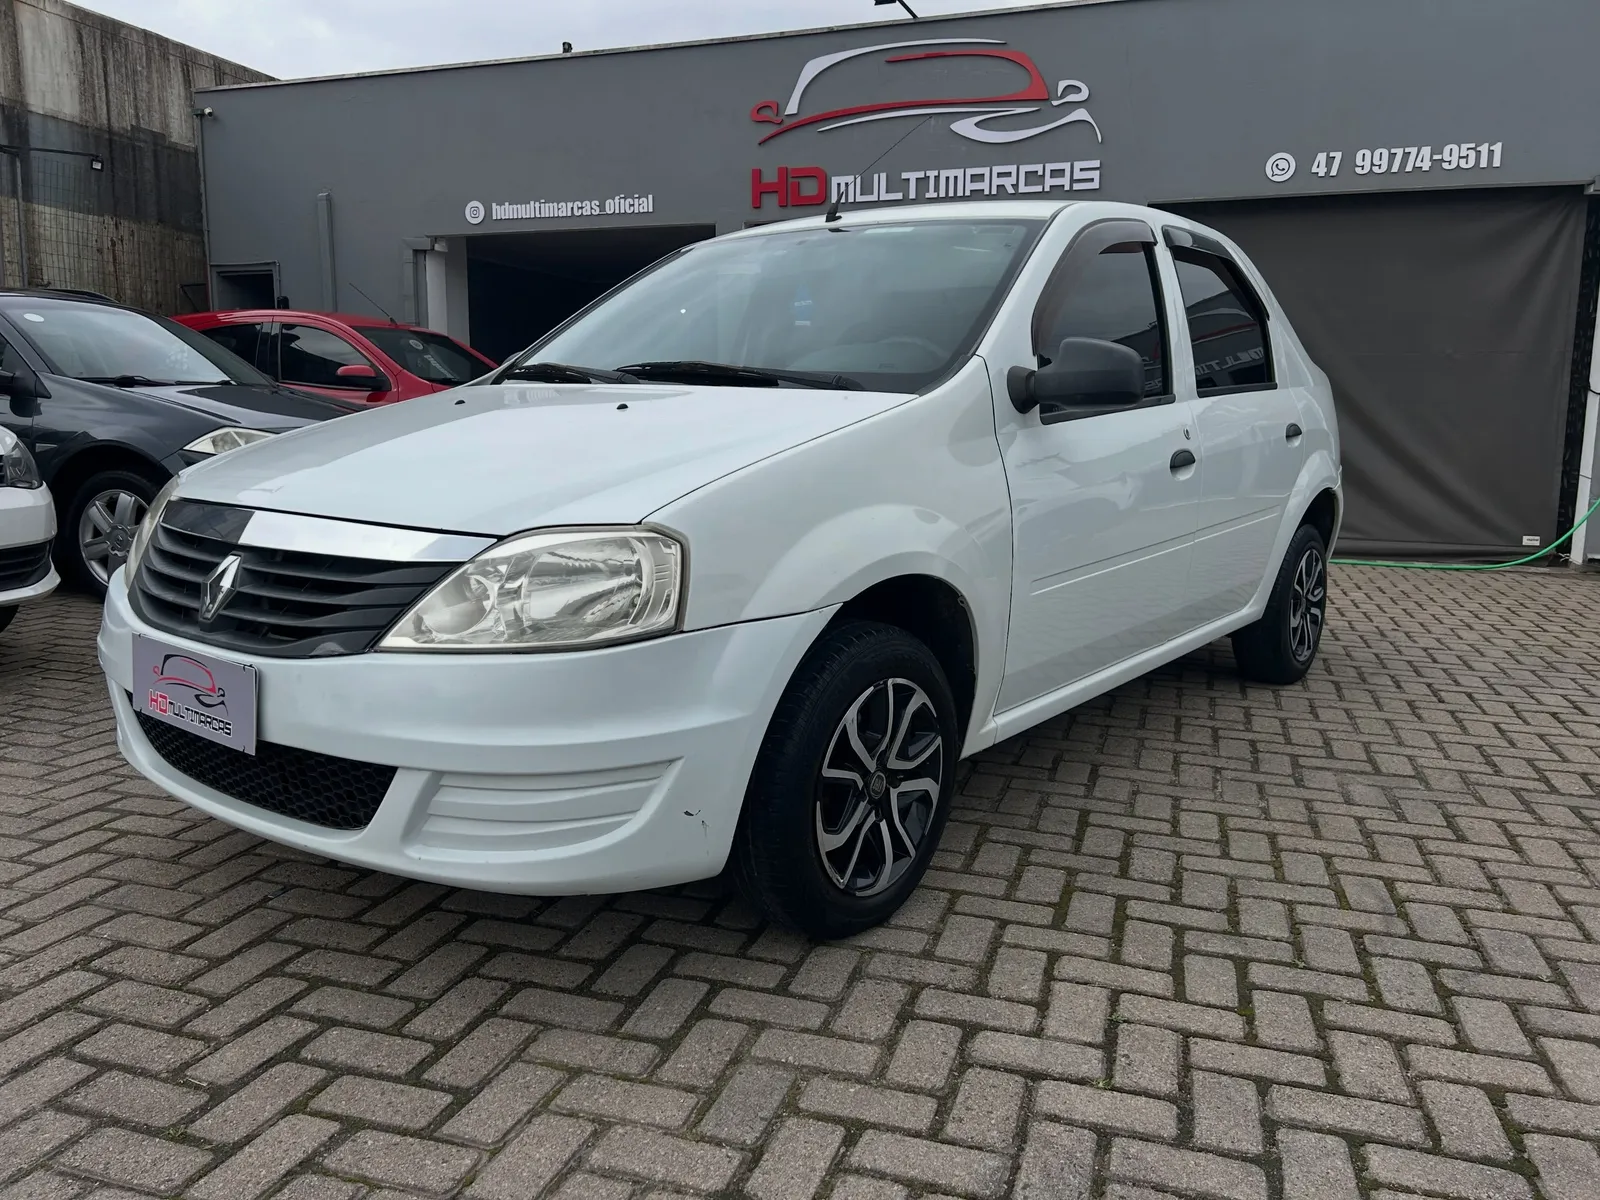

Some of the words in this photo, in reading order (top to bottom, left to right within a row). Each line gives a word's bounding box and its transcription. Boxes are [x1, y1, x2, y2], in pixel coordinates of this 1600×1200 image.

[1311, 151, 1342, 177] 47
[1354, 142, 1503, 175] 99774-9511
[491, 194, 654, 221] hdmultimarcas_oficial
